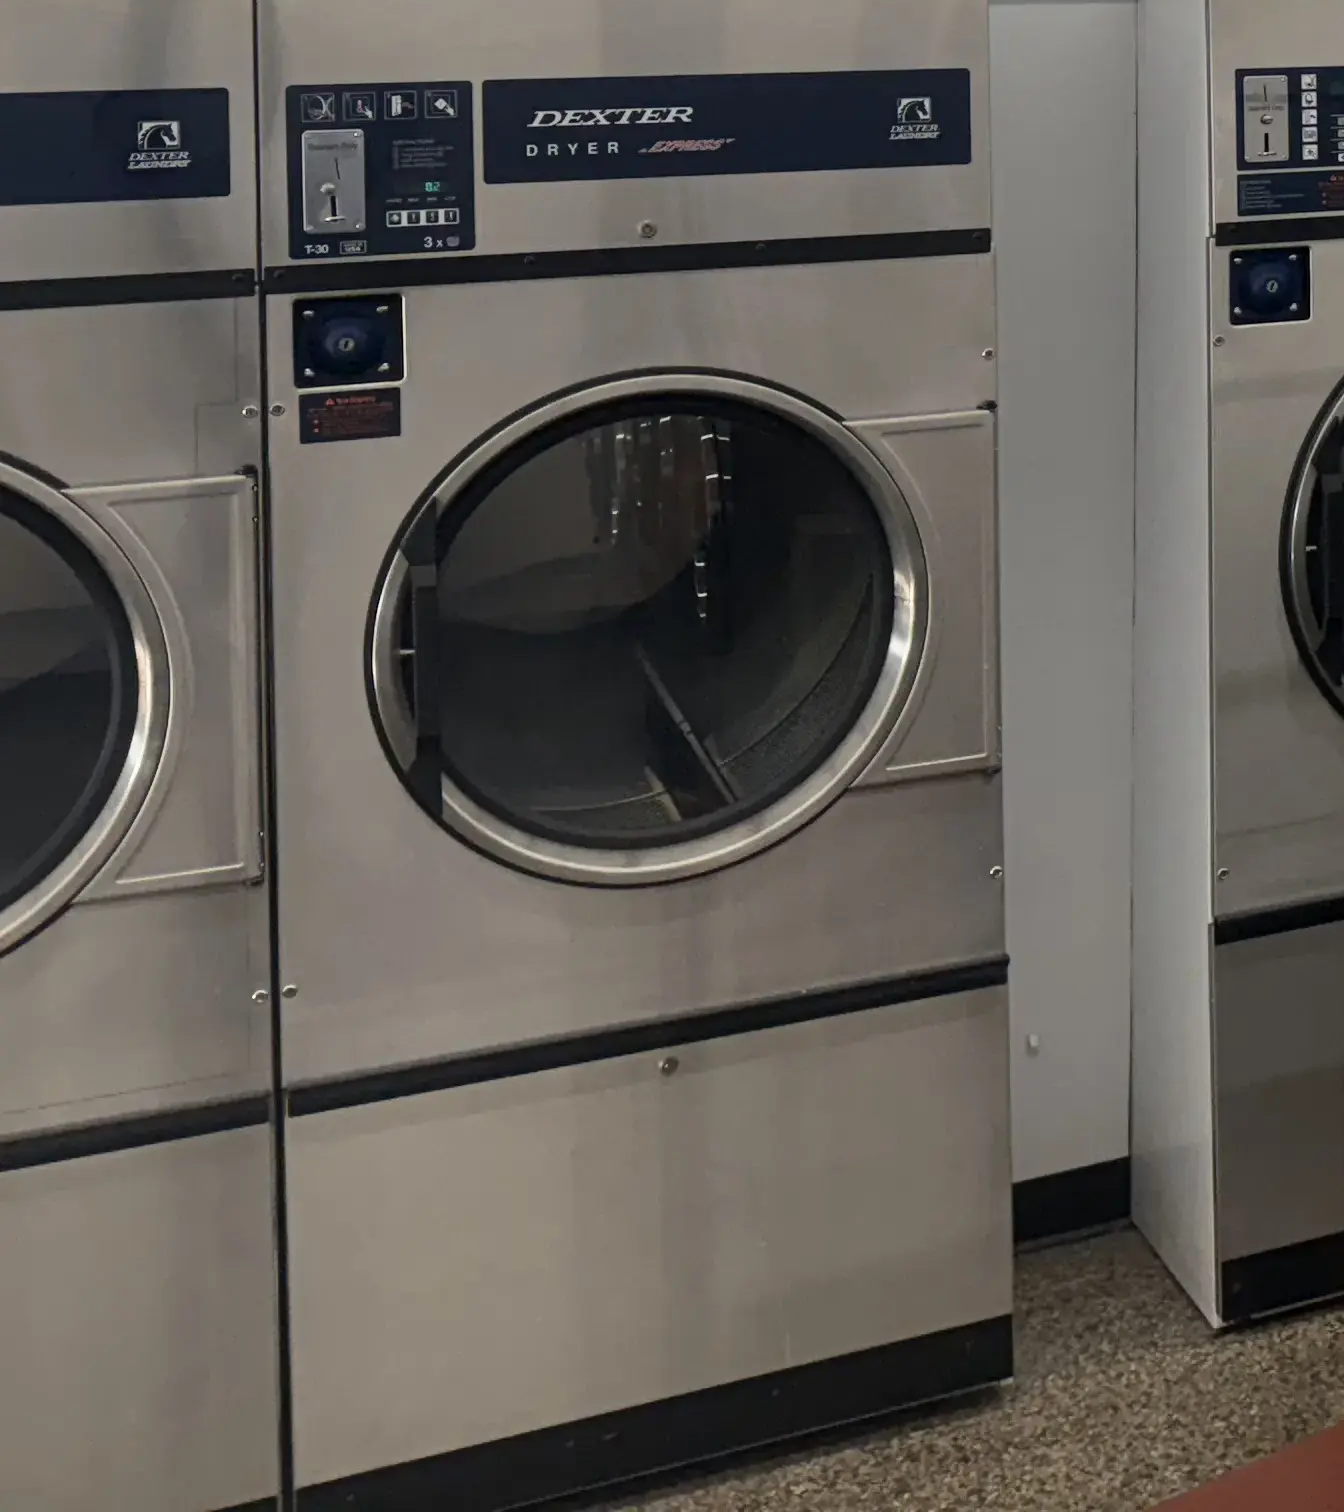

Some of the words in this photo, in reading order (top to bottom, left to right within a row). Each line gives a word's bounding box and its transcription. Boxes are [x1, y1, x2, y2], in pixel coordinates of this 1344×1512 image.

[526, 106, 694, 128] DEXTER
[890, 123, 940, 133] DEXTER
[526, 140, 619, 158] DRYER
[128, 150, 191, 161] DEXTER
[126, 159, 192, 169] LAUNDRY
[424, 236, 433, 248] 3
[436, 239, 443, 248] x
[304, 244, 329, 255] T-30
